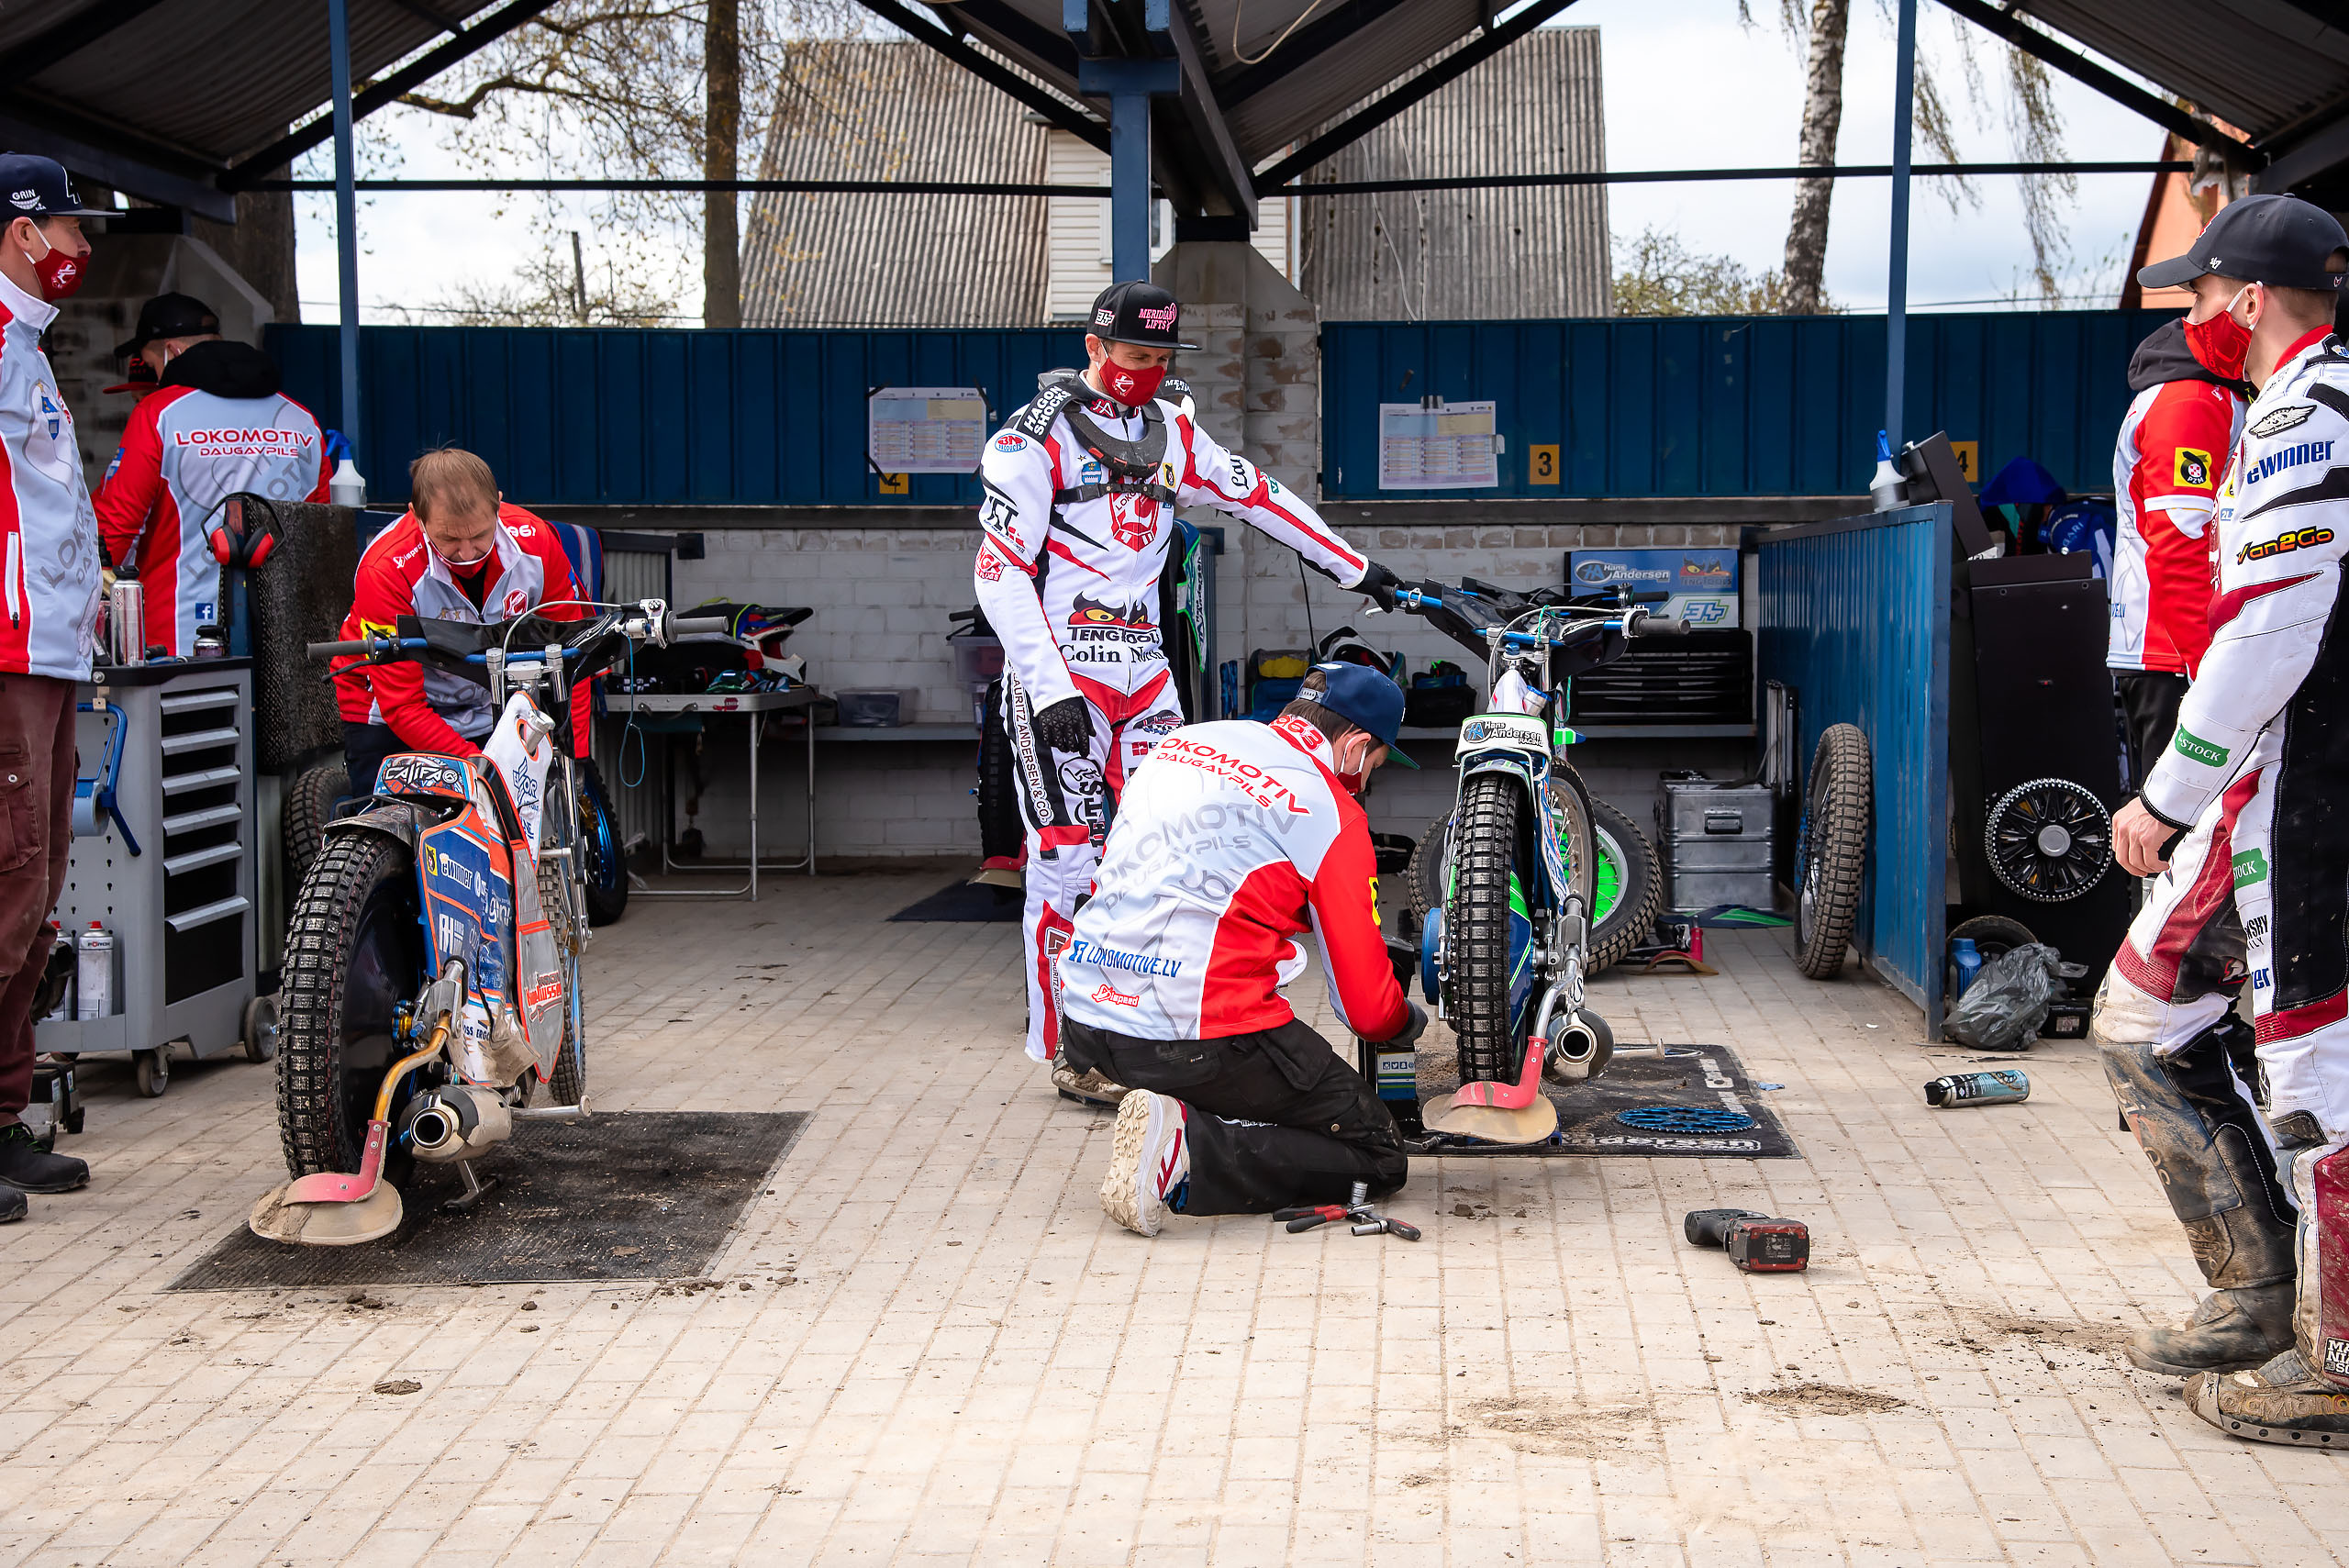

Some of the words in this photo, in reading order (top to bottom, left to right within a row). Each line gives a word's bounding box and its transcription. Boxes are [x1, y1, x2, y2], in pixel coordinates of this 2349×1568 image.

[12, 189, 36, 201] GRIN
[1145, 318, 1167, 330] LIFTS
[1023, 386, 1063, 431] HAGON
[1033, 391, 1072, 436] SHOCKS
[175, 429, 314, 448] LOKOMOTIV
[199, 446, 299, 457] DAUGAVPILS
[1538, 451, 1553, 477] 3
[2247, 440, 2335, 484] eWinner
[2187, 476, 2204, 485] PZM
[2236, 526, 2334, 565] Van2Go
[1613, 569, 1671, 580] Andersen
[1060, 644, 1122, 662] Colin
[1271, 715, 1325, 751] 963
[1484, 721, 1506, 729] Hans
[1490, 728, 1542, 741] Andersen
[1012, 672, 1026, 722] LAURITZ
[1019, 724, 1040, 786] ANDERSEN
[1033, 790, 1042, 798] &
[1519, 738, 1543, 747] RACING
[1153, 738, 1310, 815] OKOMOTIV
[1156, 752, 1273, 808] DAUGAVPILS
